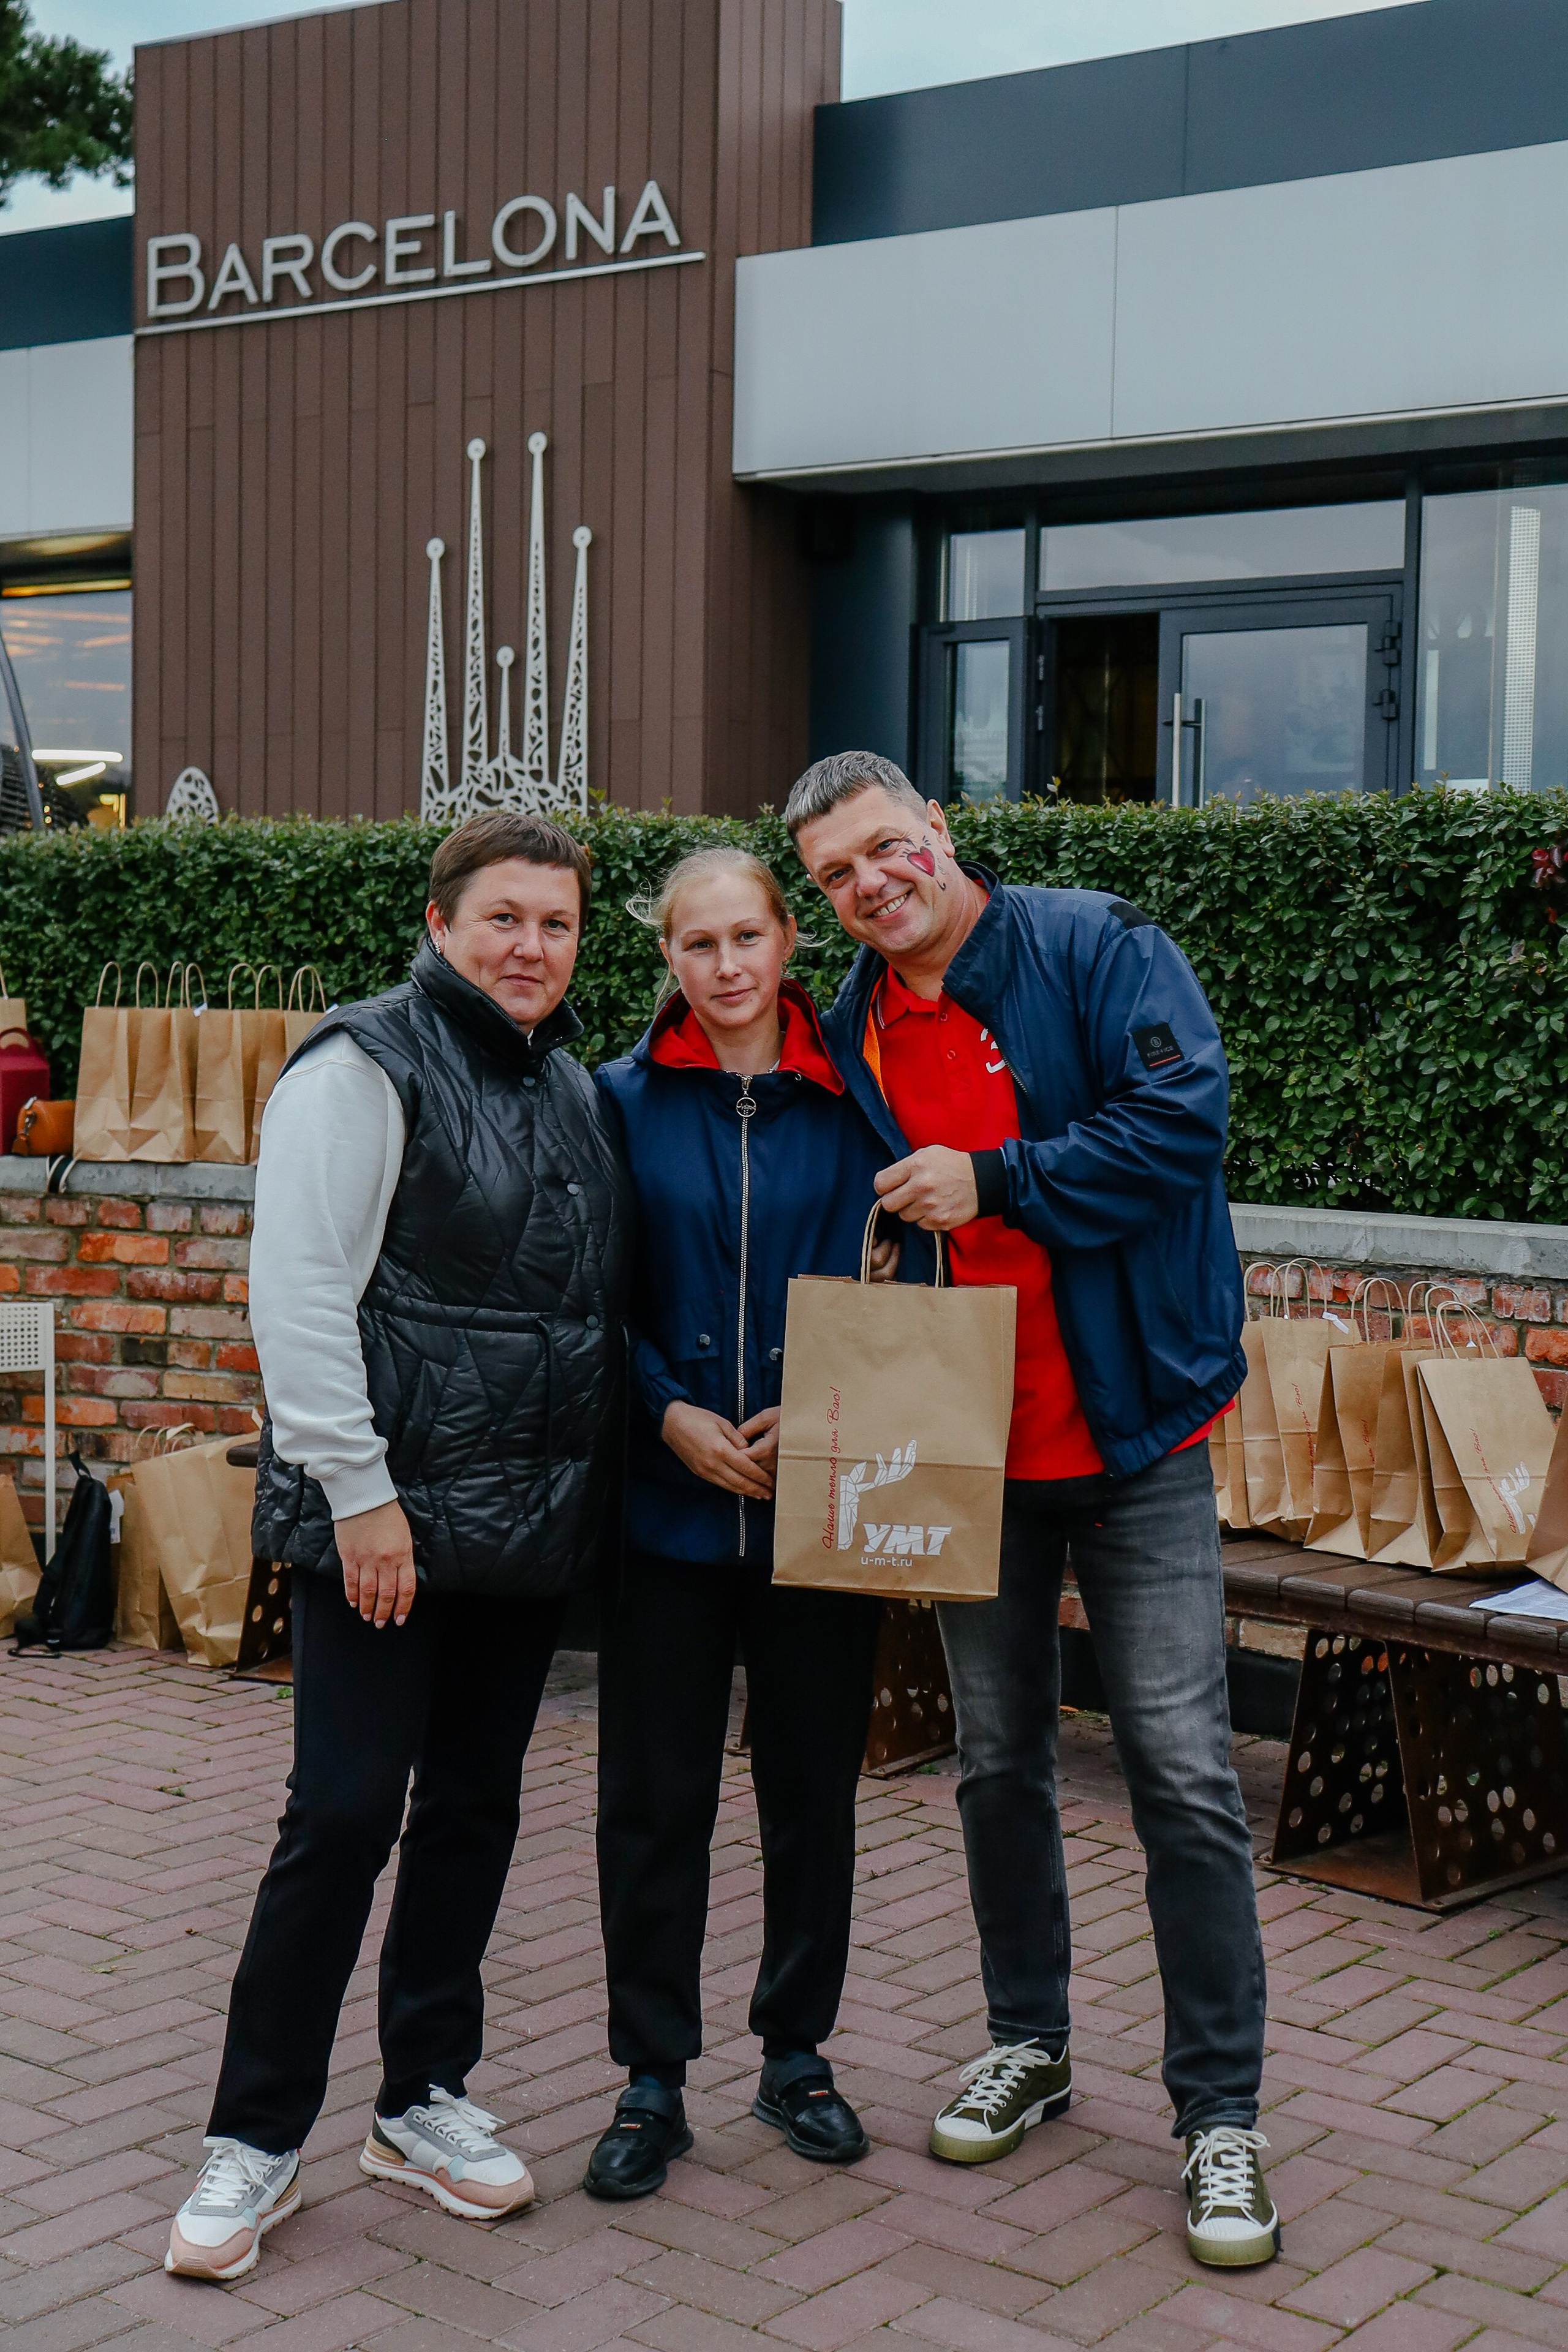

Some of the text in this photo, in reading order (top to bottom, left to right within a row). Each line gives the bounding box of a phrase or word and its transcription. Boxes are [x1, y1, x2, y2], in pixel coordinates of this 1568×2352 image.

[146, 179, 681, 318] BARCELONA
[822, 1386, 841, 1550] Наше тепло для Вас!
[860, 1556, 913, 1567] u-m-t.ru
